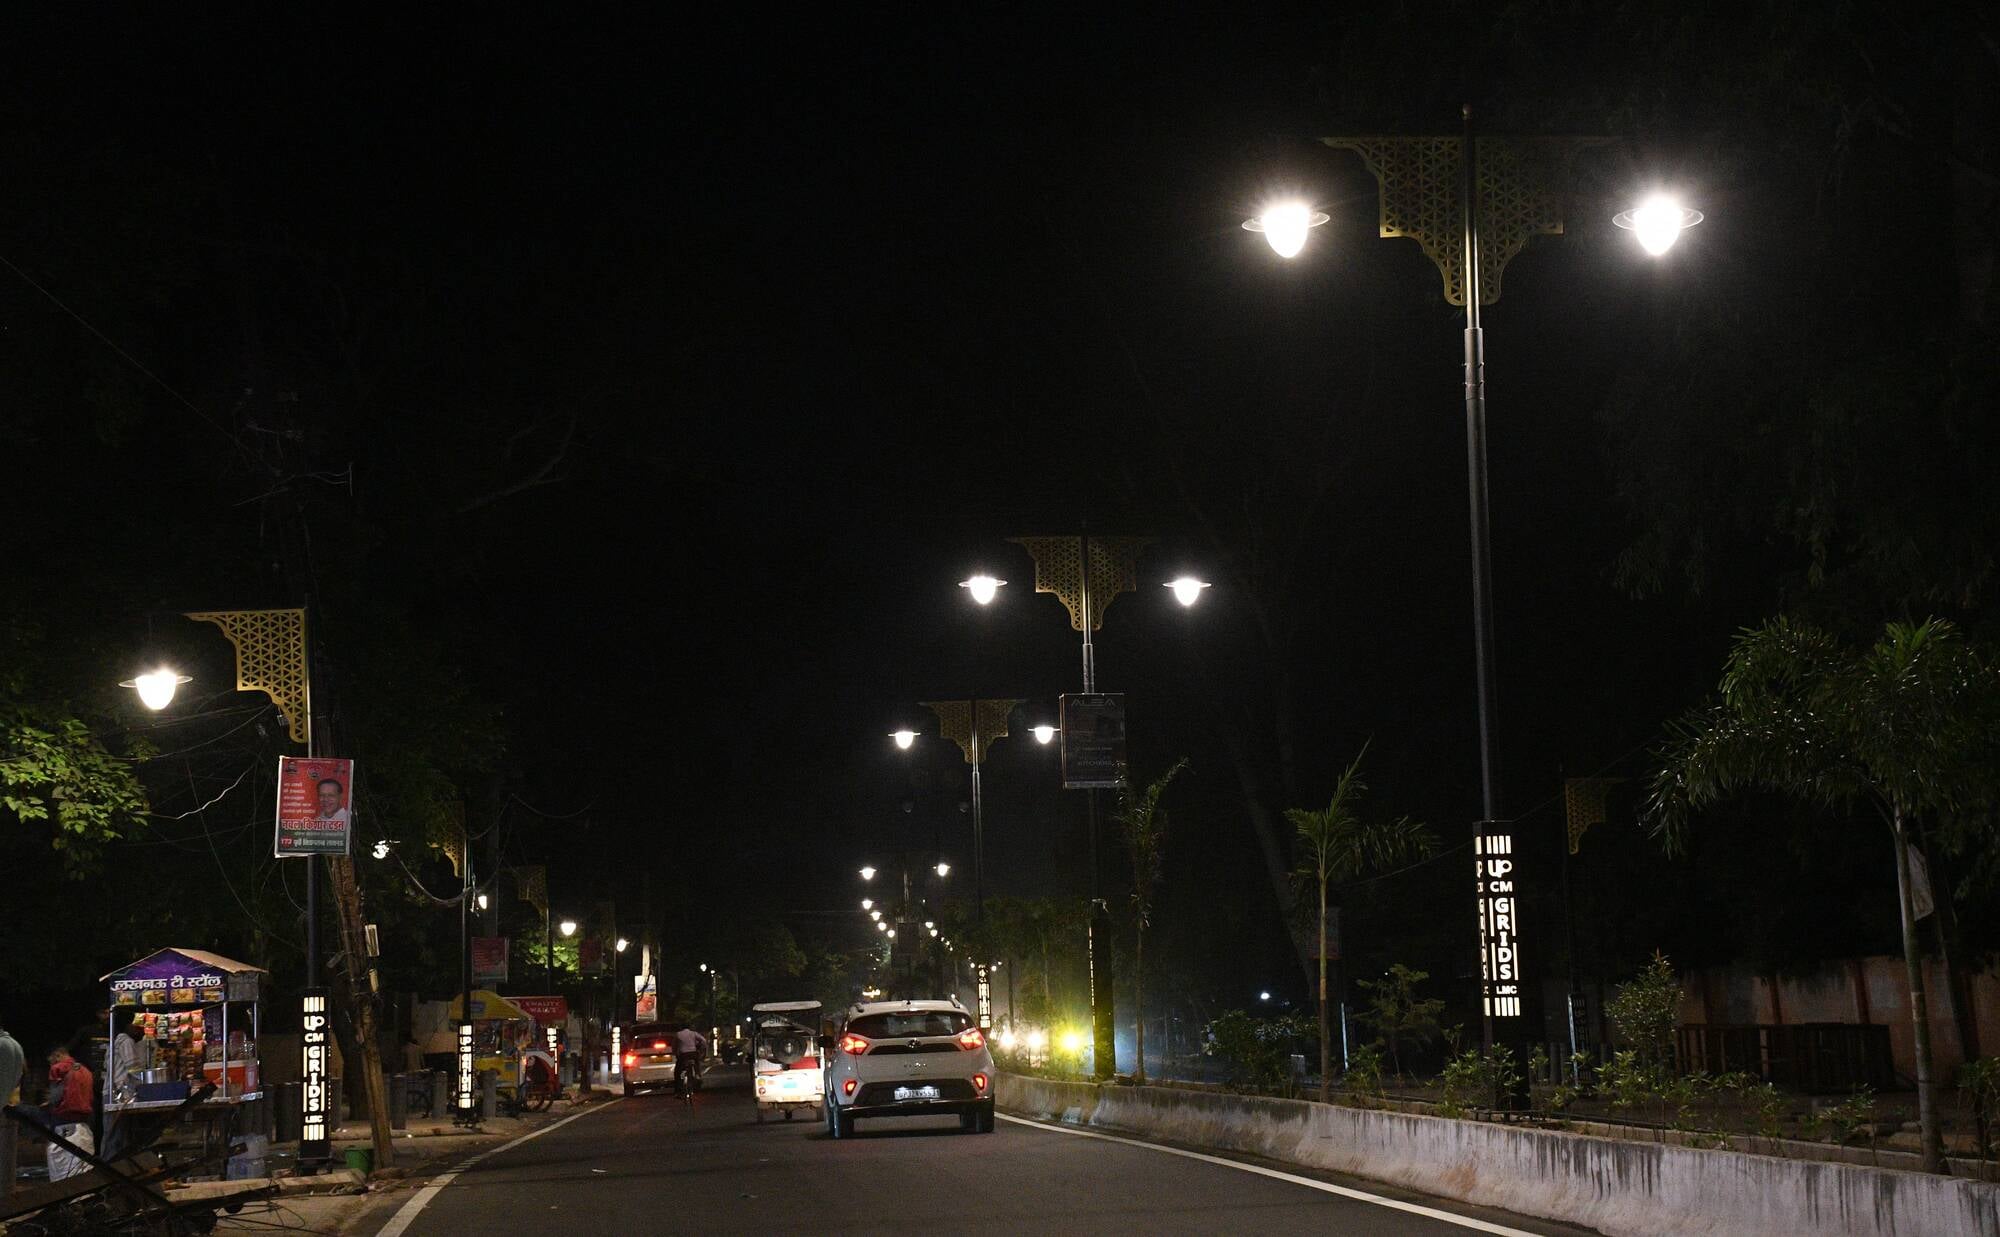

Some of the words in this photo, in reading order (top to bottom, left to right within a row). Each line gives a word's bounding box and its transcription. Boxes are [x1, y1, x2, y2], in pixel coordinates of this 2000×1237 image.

[1487, 859, 1512, 877] UP
[1490, 881, 1513, 892] CM
[1495, 898, 1512, 980] GRIDS
[111, 978, 167, 991] लखनऊ
[171, 975, 184, 988] टी
[187, 974, 222, 987] स्टॉल
[1496, 985, 1517, 995] LMC
[303, 1015, 325, 1031] UP
[304, 1032, 324, 1043] CM
[308, 1045, 321, 1112] GRIDS
